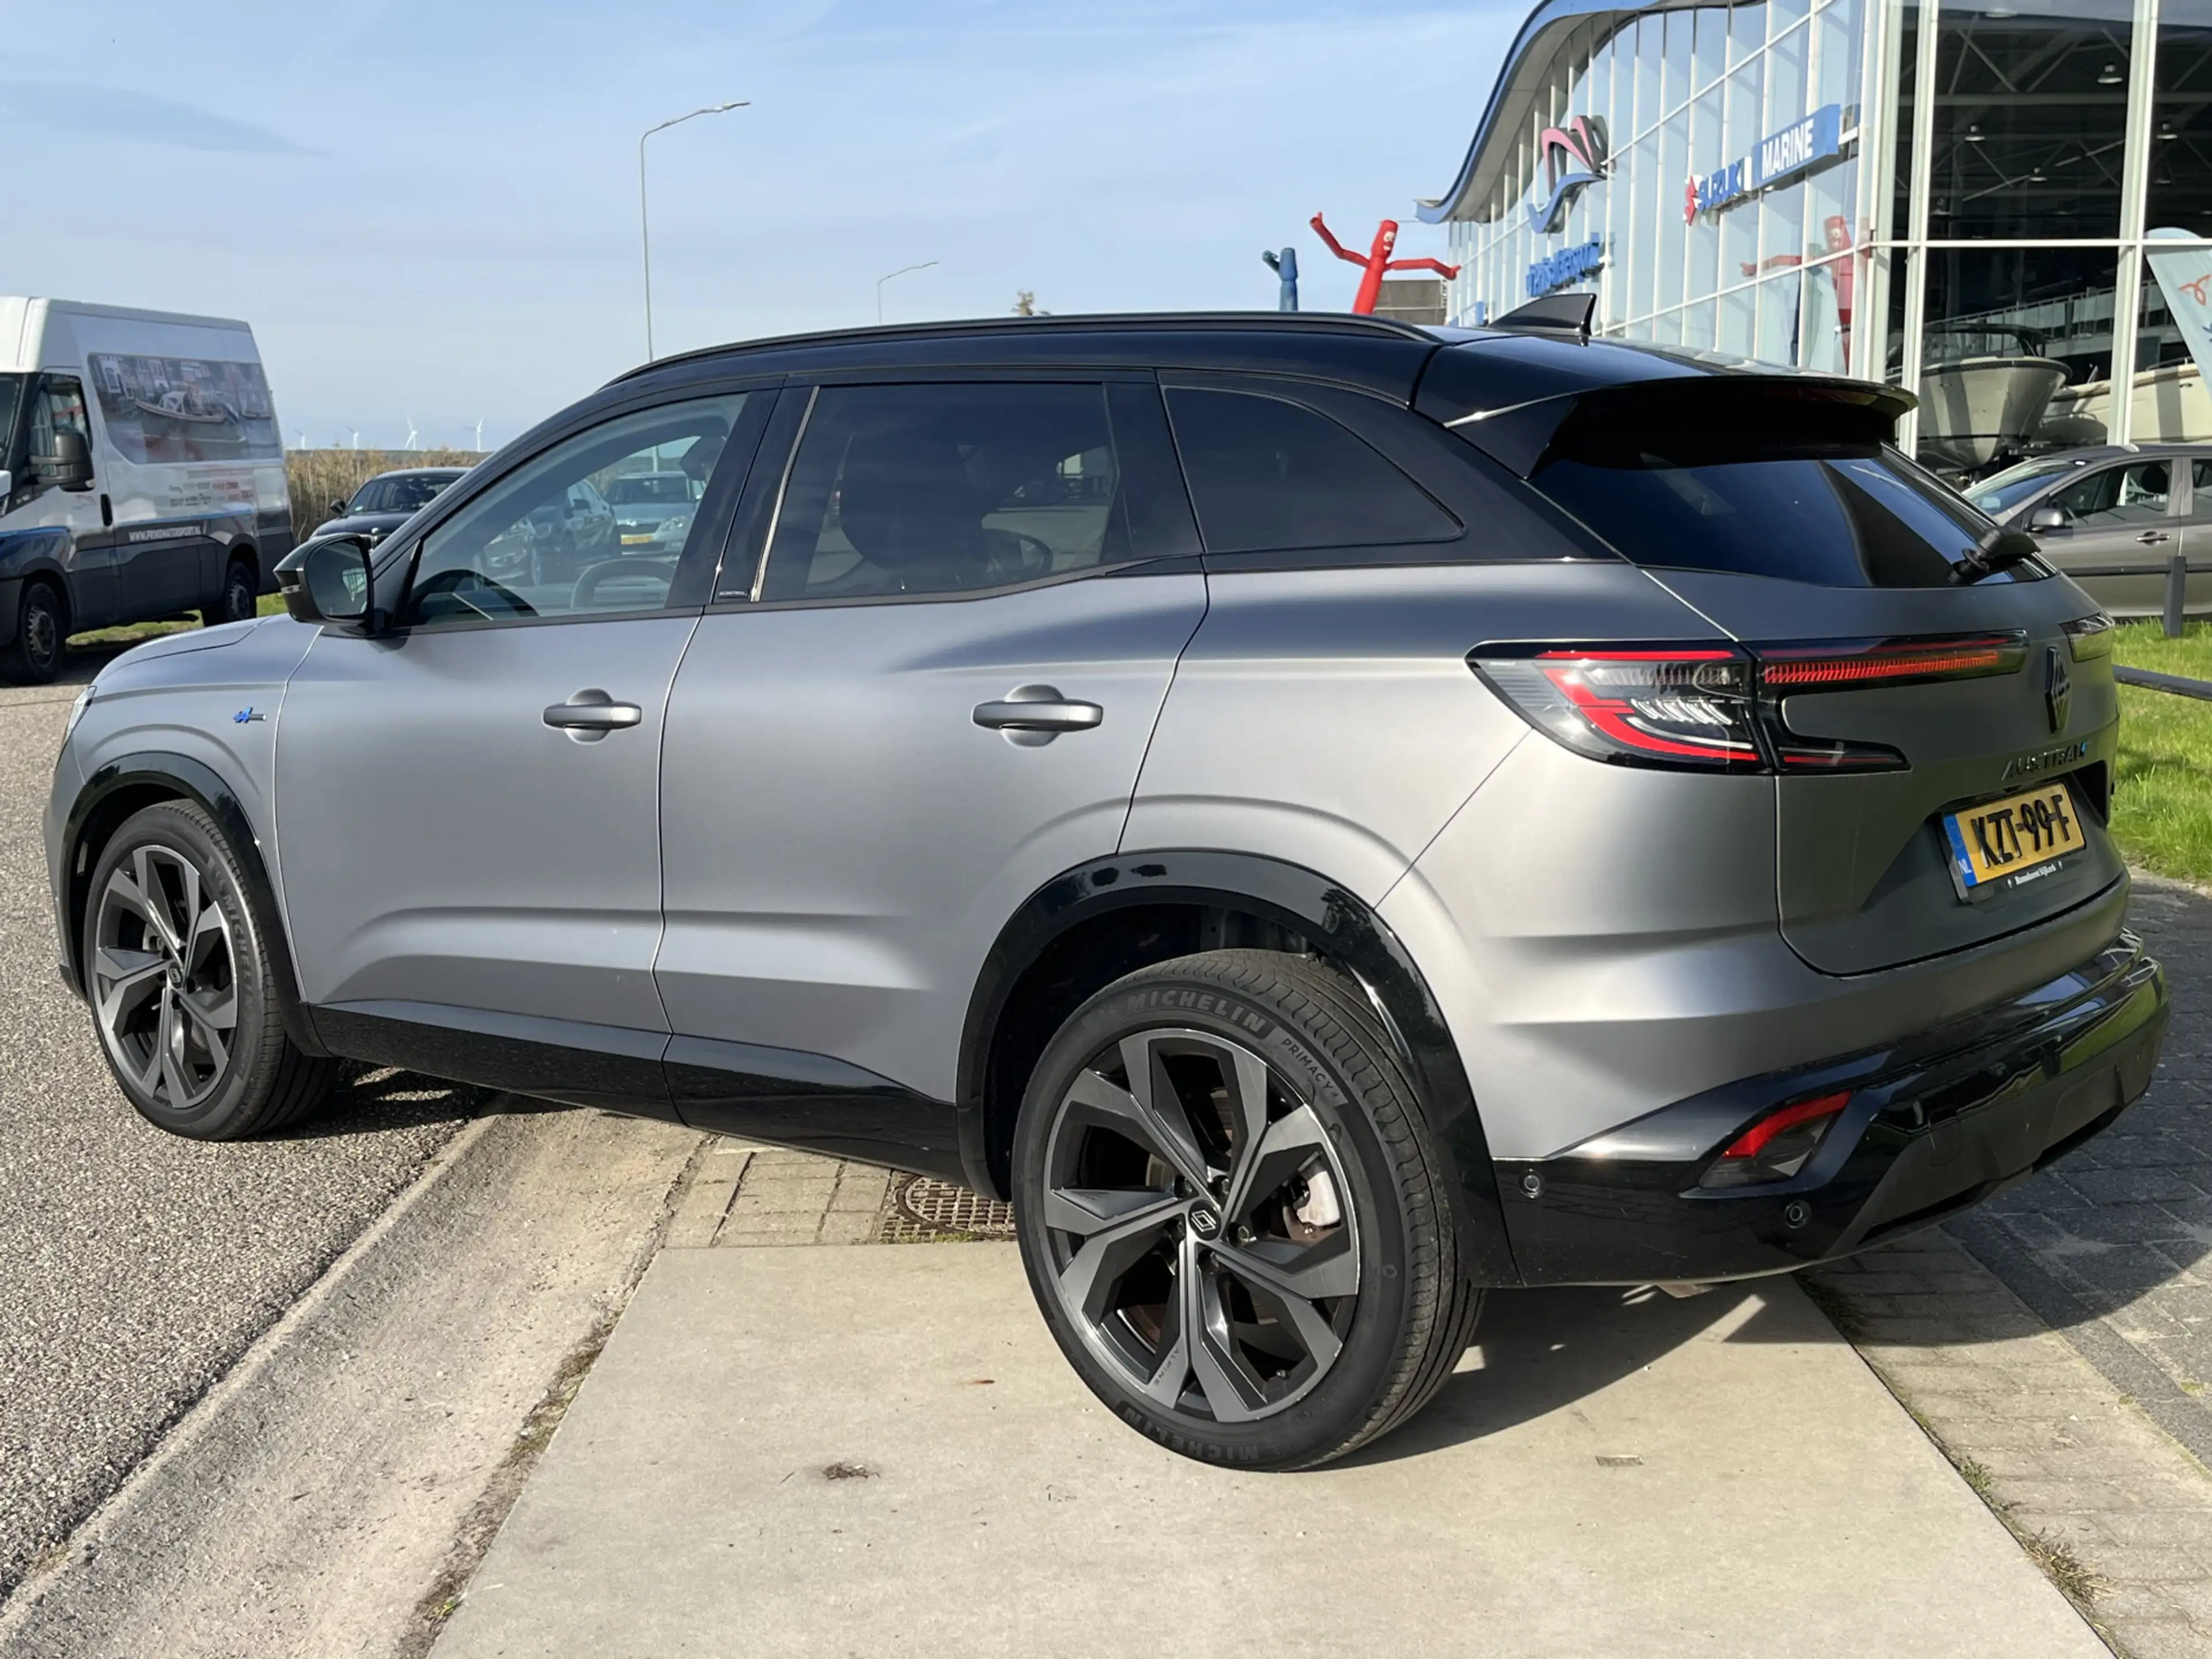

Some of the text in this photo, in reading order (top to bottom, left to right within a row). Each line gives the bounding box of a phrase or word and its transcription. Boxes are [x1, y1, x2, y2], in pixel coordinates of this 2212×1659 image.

[1761, 118, 1815, 180] MARINE
[2001, 744, 2085, 781] AUSTRAL
[1971, 794, 2069, 869] KZT-99-F
[1958, 858, 1972, 874] NL
[1127, 989, 1266, 1033] MICHELIN
[1281, 1038, 1333, 1089] PRIMACY
[1123, 1407, 1259, 1461] MICHELIN
